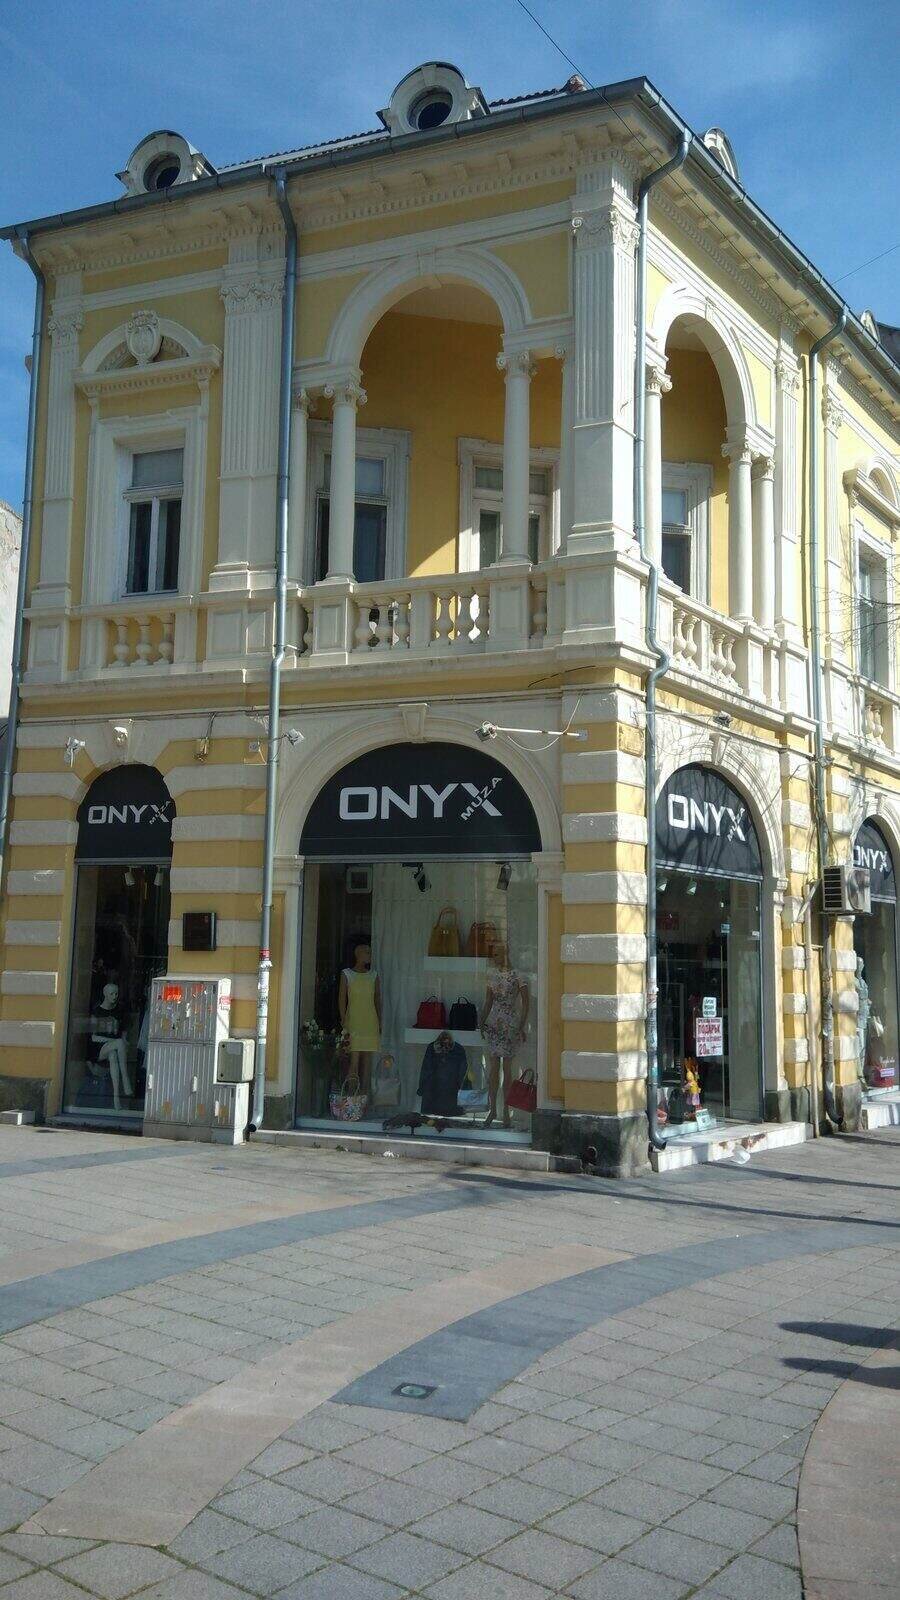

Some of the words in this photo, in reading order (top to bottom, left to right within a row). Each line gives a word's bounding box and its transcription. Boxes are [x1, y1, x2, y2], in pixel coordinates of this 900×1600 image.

[87, 804, 170, 824] ONYX
[339, 782, 503, 820] ONYX
[461, 776, 504, 821] MUZA
[667, 792, 746, 842] ONYX
